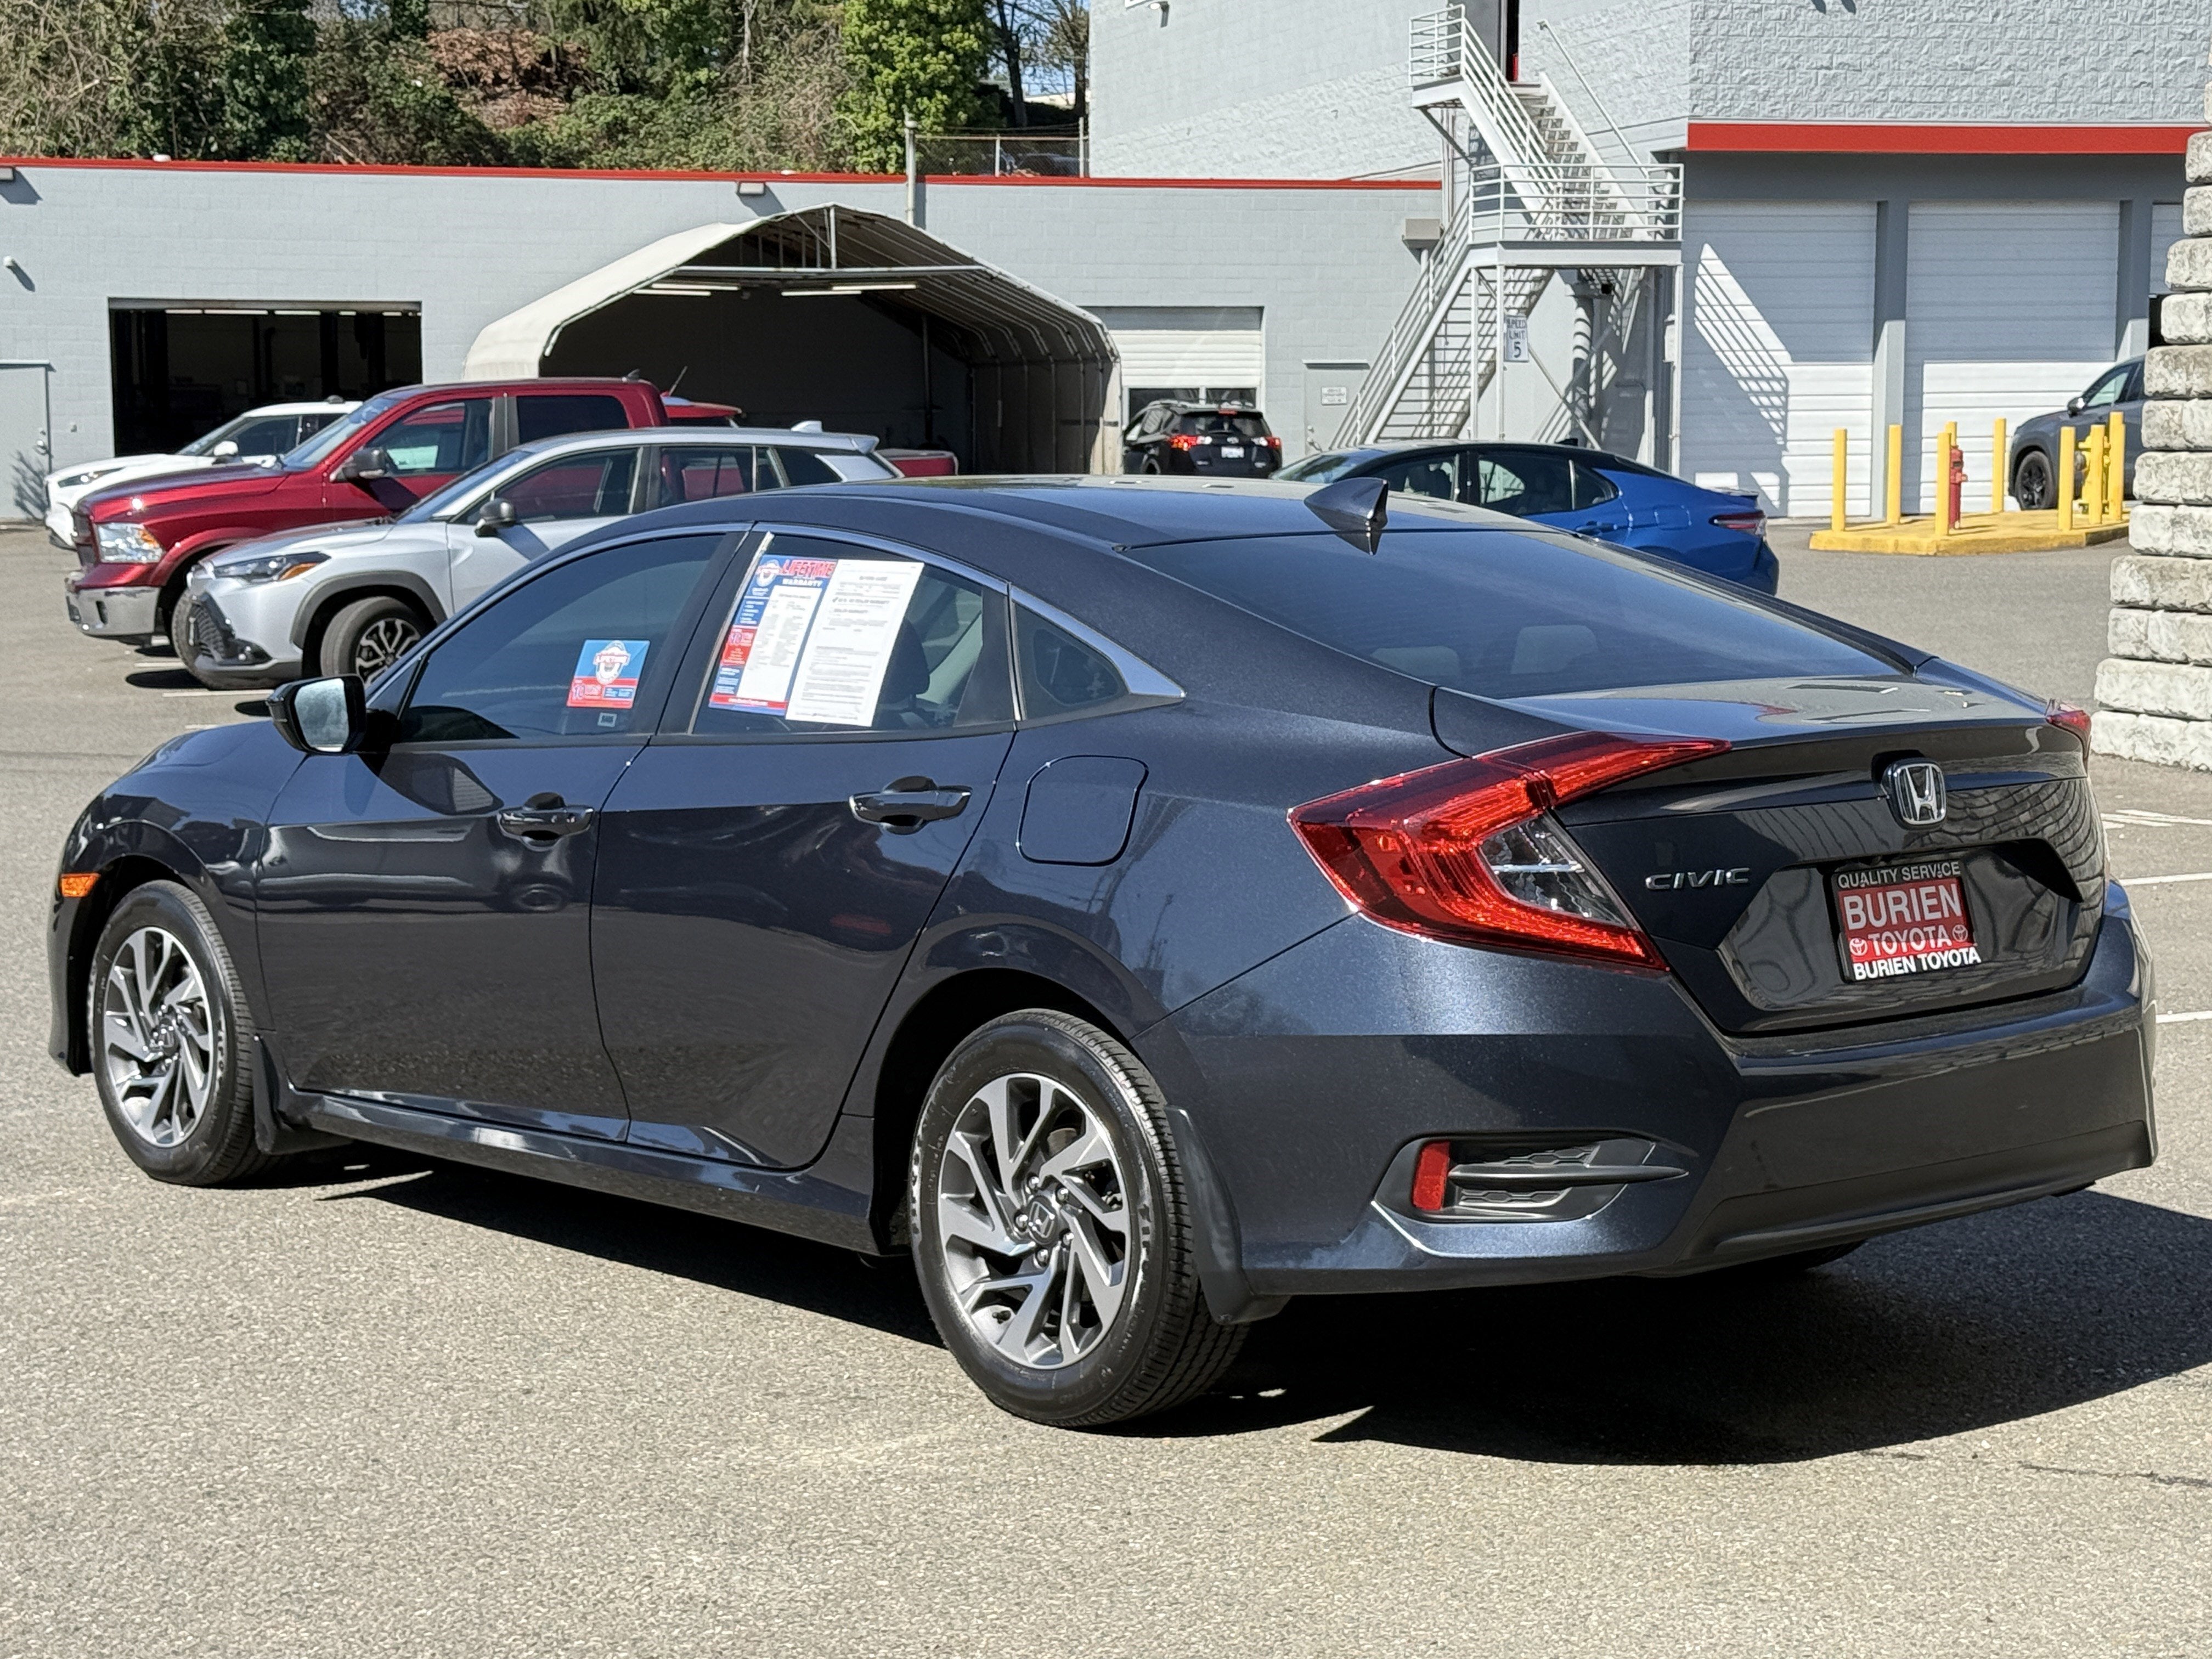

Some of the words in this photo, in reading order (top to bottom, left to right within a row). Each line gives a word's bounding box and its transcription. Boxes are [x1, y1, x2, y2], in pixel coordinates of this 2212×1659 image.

[1506, 318, 1526, 329] SPEED
[1509, 330, 1525, 340] LIMIT
[1514, 341, 1521, 358] 5
[780, 558, 837, 579] LIFETIME
[782, 578, 823, 587] WARRANTY
[1645, 867, 1750, 890] CIVIC
[1838, 867, 1898, 889] QUALITY
[1901, 861, 1961, 882] SERVICE
[1843, 883, 1962, 930] BURIEN
[1867, 924, 1953, 956] TOYOTA
[1853, 955, 1917, 981] BURIEN
[1917, 946, 1982, 971] TOYOTA
